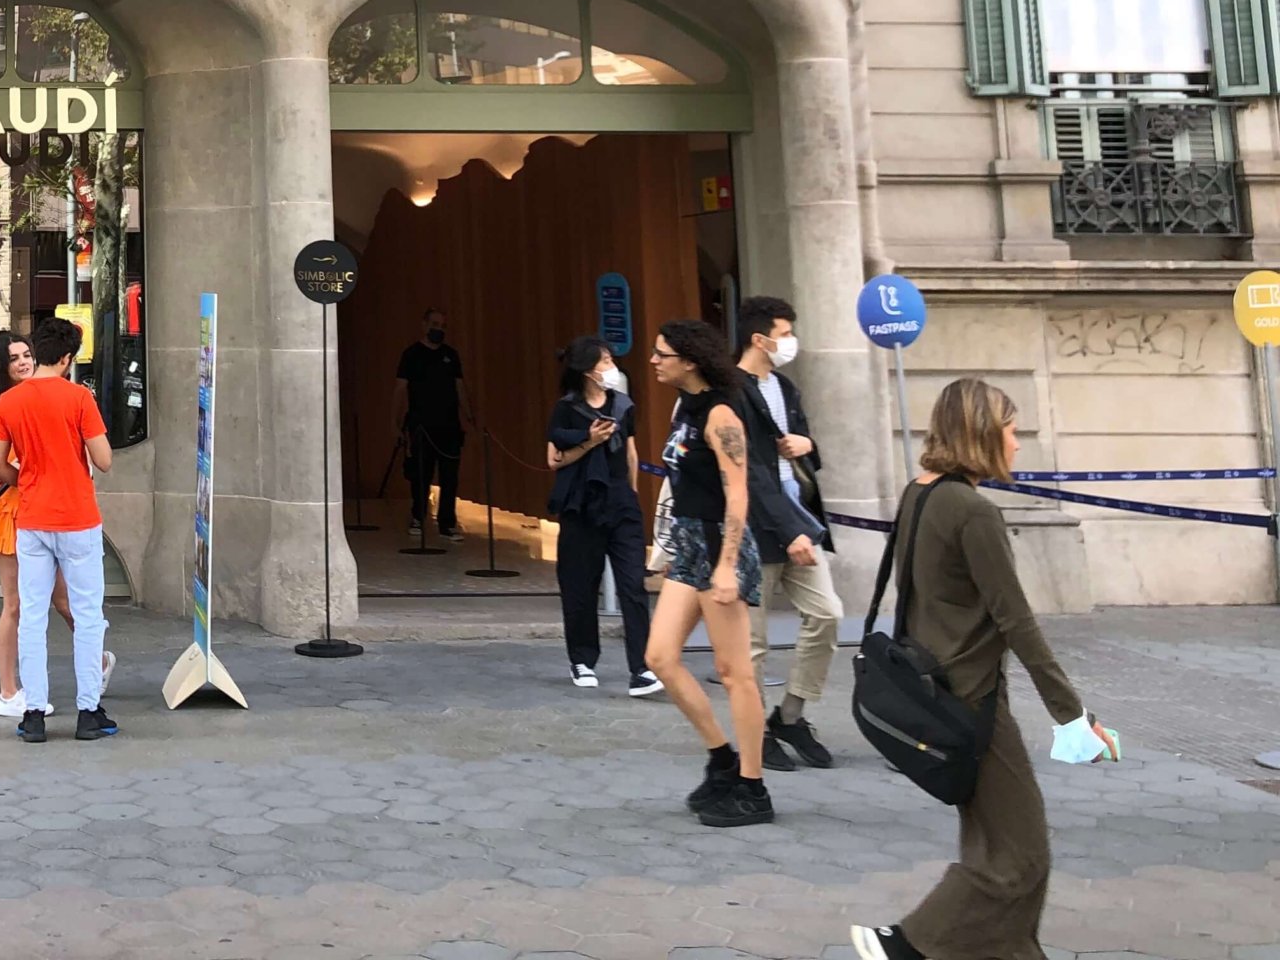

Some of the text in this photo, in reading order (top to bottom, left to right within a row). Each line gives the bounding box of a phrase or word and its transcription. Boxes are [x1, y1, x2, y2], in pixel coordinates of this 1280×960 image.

[297, 271, 354, 282] SIMBOLIC
[307, 282, 344, 293] STORE
[868, 320, 920, 335] FASTPASS
[1254, 316, 1280, 328] GOLD
